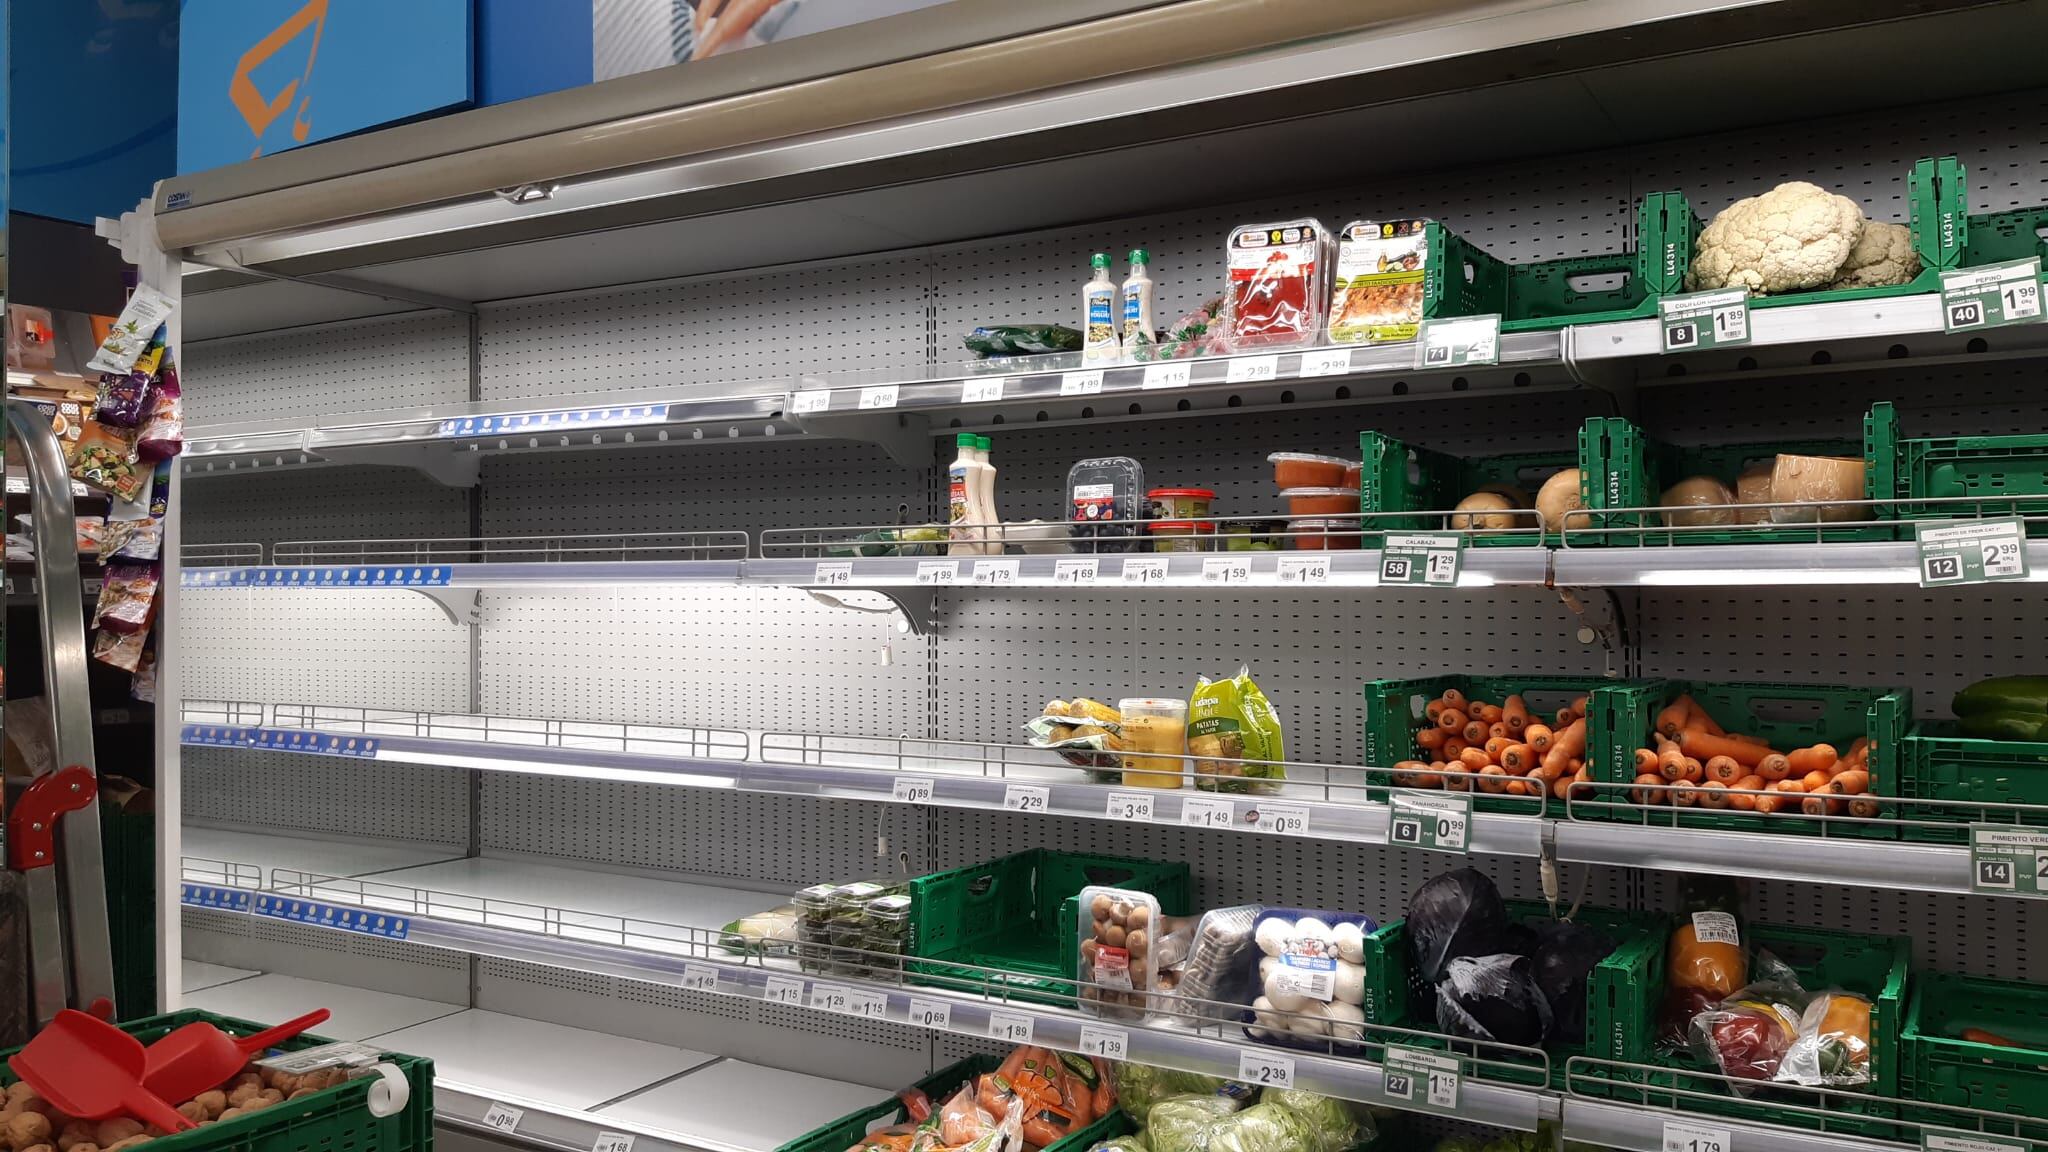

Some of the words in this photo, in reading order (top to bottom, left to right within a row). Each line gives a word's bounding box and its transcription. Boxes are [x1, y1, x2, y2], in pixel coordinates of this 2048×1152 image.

[1944, 212, 1953, 248] LL4314
[1666, 243, 1675, 276] LL4314
[1425, 269, 1433, 298] LL4314
[1955, 308, 1975, 320] 40
[1677, 329, 1686, 341] 8
[1430, 349, 1445, 359] 71
[1610, 471, 1619, 505] LL4314
[1388, 563, 1404, 574] 58
[1932, 560, 1953, 574] 12
[1195, 697, 1219, 708] udapa
[1196, 719, 1219, 729] PATATAS
[1367, 732, 1375, 763] LL4314
[1614, 745, 1622, 778] LL4314
[1402, 825, 1410, 836] 6
[1992, 834, 2028, 842] PIMIENTO
[1985, 865, 2006, 879] 14
[1366, 988, 1374, 1019] LL4314
[1614, 1022, 1623, 1056] LL4314
[1405, 1053, 1437, 1064] LOMBARDA
[1390, 1077, 1406, 1089] 27
